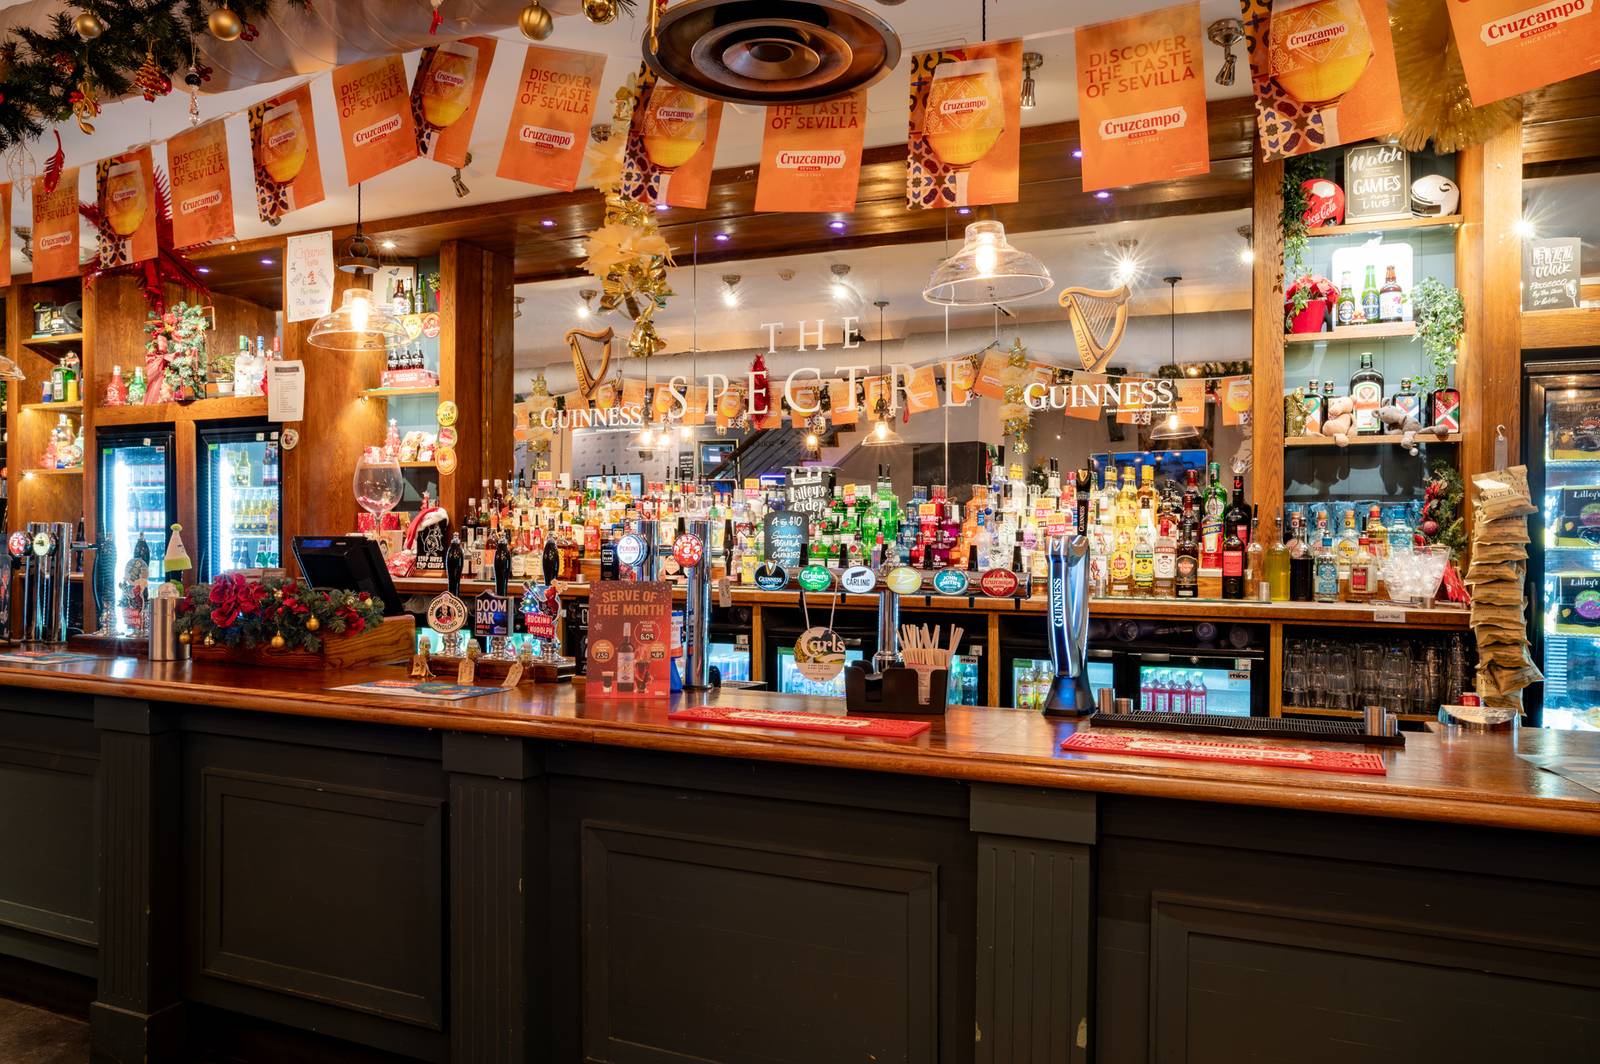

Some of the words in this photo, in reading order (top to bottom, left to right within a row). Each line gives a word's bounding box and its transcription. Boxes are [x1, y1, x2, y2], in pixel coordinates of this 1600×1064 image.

[1488, 0, 1586, 39] Cruzcampo
[1290, 24, 1346, 45] Cruzcampo
[1089, 36, 1187, 68] DISCOVER
[1086, 66, 1122, 84] THE
[1132, 51, 1193, 75] TASTE
[341, 63, 396, 95] DISCOVER
[437, 70, 465, 85] Cruzcampo
[530, 68, 592, 88] DISCOVER
[1086, 84, 1110, 99] OF
[1118, 66, 1195, 93] SEVILLA
[341, 93, 362, 107] THE
[367, 75, 401, 98] TASTE
[525, 81, 547, 95] THE
[553, 86, 591, 102] TASTE
[342, 107, 356, 119] OF
[361, 87, 404, 111] SEVILLA
[521, 93, 542, 106] OF
[547, 97, 589, 115] SEVILLA
[775, 102, 803, 115] THE
[811, 101, 858, 115] TASTE
[942, 99, 986, 112] Cruzcampo
[659, 108, 694, 119] Cruzcampo
[771, 117, 791, 129] OF
[797, 116, 858, 129] SEVILLA
[1104, 111, 1181, 135] Cruzcampo
[270, 129, 296, 144] Cruzcampo
[356, 117, 399, 143] Cruzcampo
[523, 127, 571, 145] Cruzcampo
[173, 143, 221, 166] DISCOVER
[780, 152, 841, 166] Cruzcampo
[1350, 147, 1402, 172] Watch
[172, 164, 188, 175] THE
[193, 155, 224, 171] TASTE
[174, 176, 185, 187] OF
[188, 164, 225, 182] SEVILLA
[1353, 175, 1401, 195] GAMES
[36, 187, 74, 202] DISCOVER
[183, 193, 220, 211] Cruzcampo
[36, 203, 48, 212] THE
[49, 198, 76, 210] TASTE
[35, 213, 46, 223] OF
[47, 207, 76, 220] SEVILLA
[41, 234, 71, 247] Cruzcampo
[760, 316, 861, 354] THE
[668, 359, 972, 419] SPECTRE
[1023, 380, 1174, 410] GUINNESS
[541, 406, 642, 430] GUINNESS
[789, 485, 827, 502] Lilley's
[1574, 490, 1600, 500] Lilley's
[800, 569, 829, 580] Carlsberg
[846, 577, 871, 587] CARLING
[1571, 579, 1599, 588] Lilley's
[476, 600, 508, 612] DOOM
[602, 590, 640, 603] SERVE
[642, 591, 658, 602] OF
[1054, 578, 1063, 627] GUINNESS
[429, 598, 443, 616] TIMOTHY
[596, 604, 618, 616] THE
[623, 604, 664, 616] MONTH
[433, 620, 458, 630] LANDLORD
[476, 612, 495, 625] BAR
[800, 633, 846, 658] Carls
